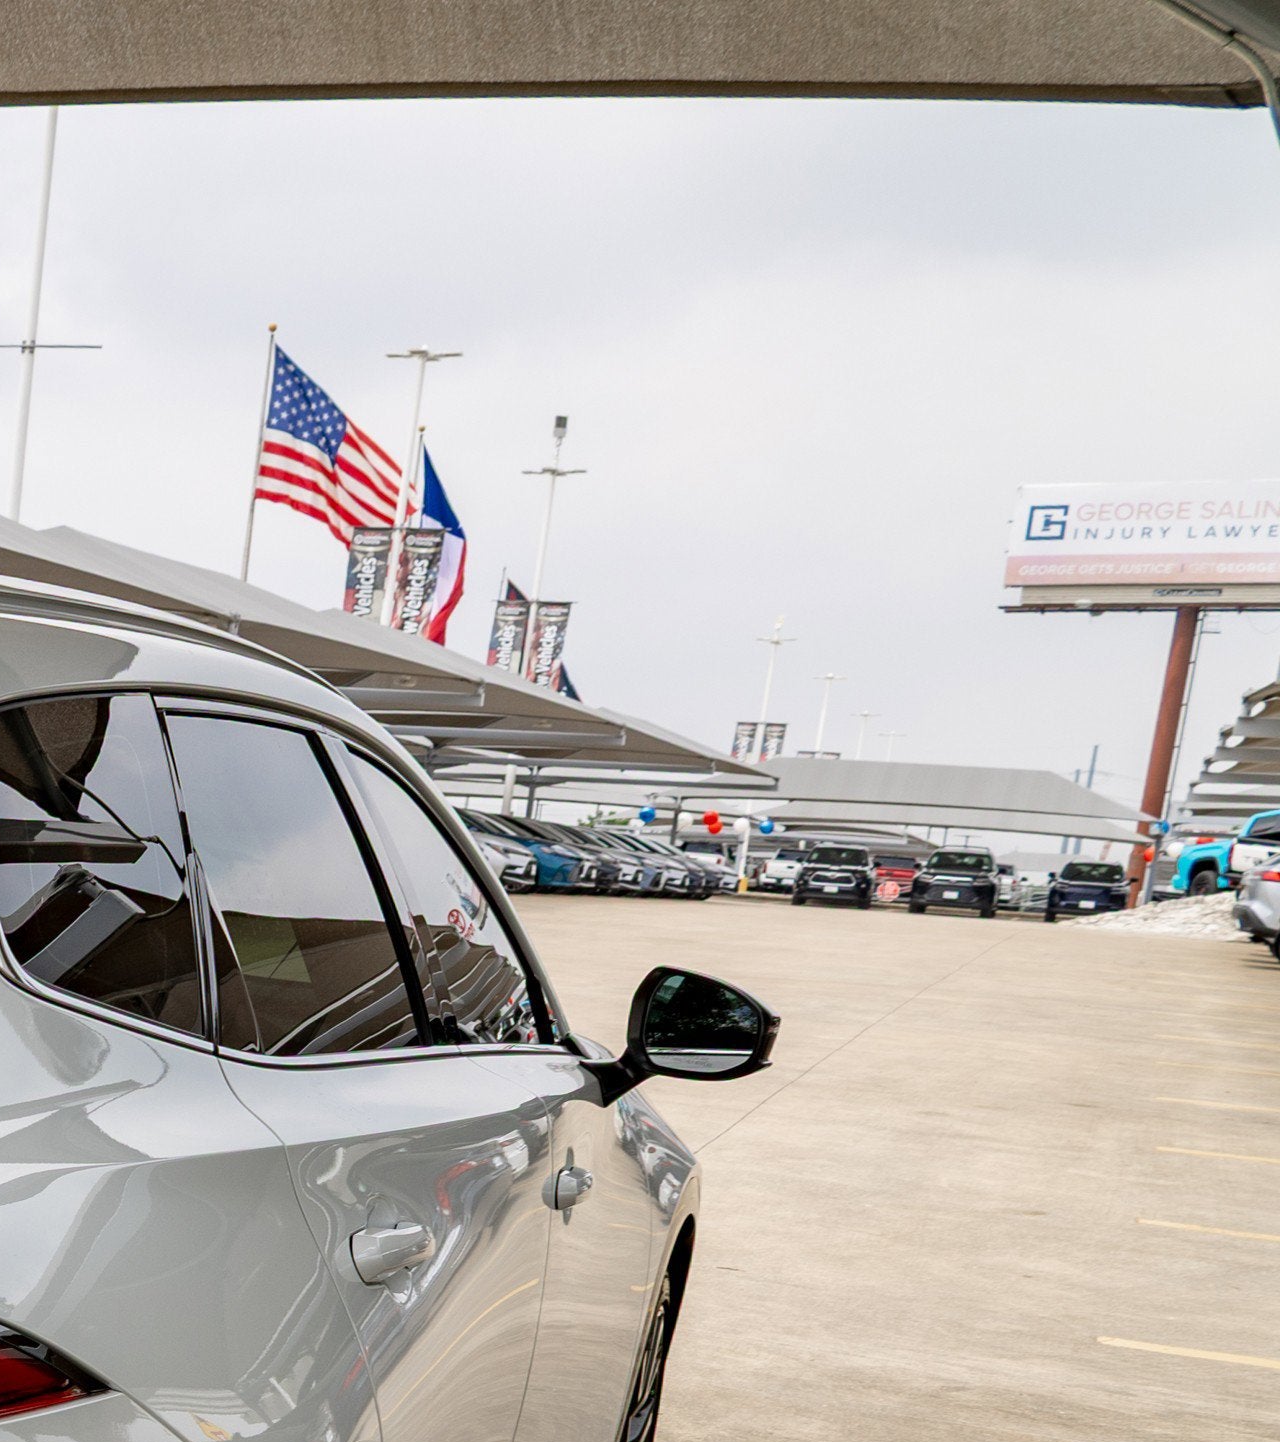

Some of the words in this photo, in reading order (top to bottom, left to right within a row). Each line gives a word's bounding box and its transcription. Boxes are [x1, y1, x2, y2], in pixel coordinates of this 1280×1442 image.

[1076, 502, 1192, 521] GEORGE
[1073, 526, 1171, 540] INJURY
[1187, 524, 1278, 539] LAWYE
